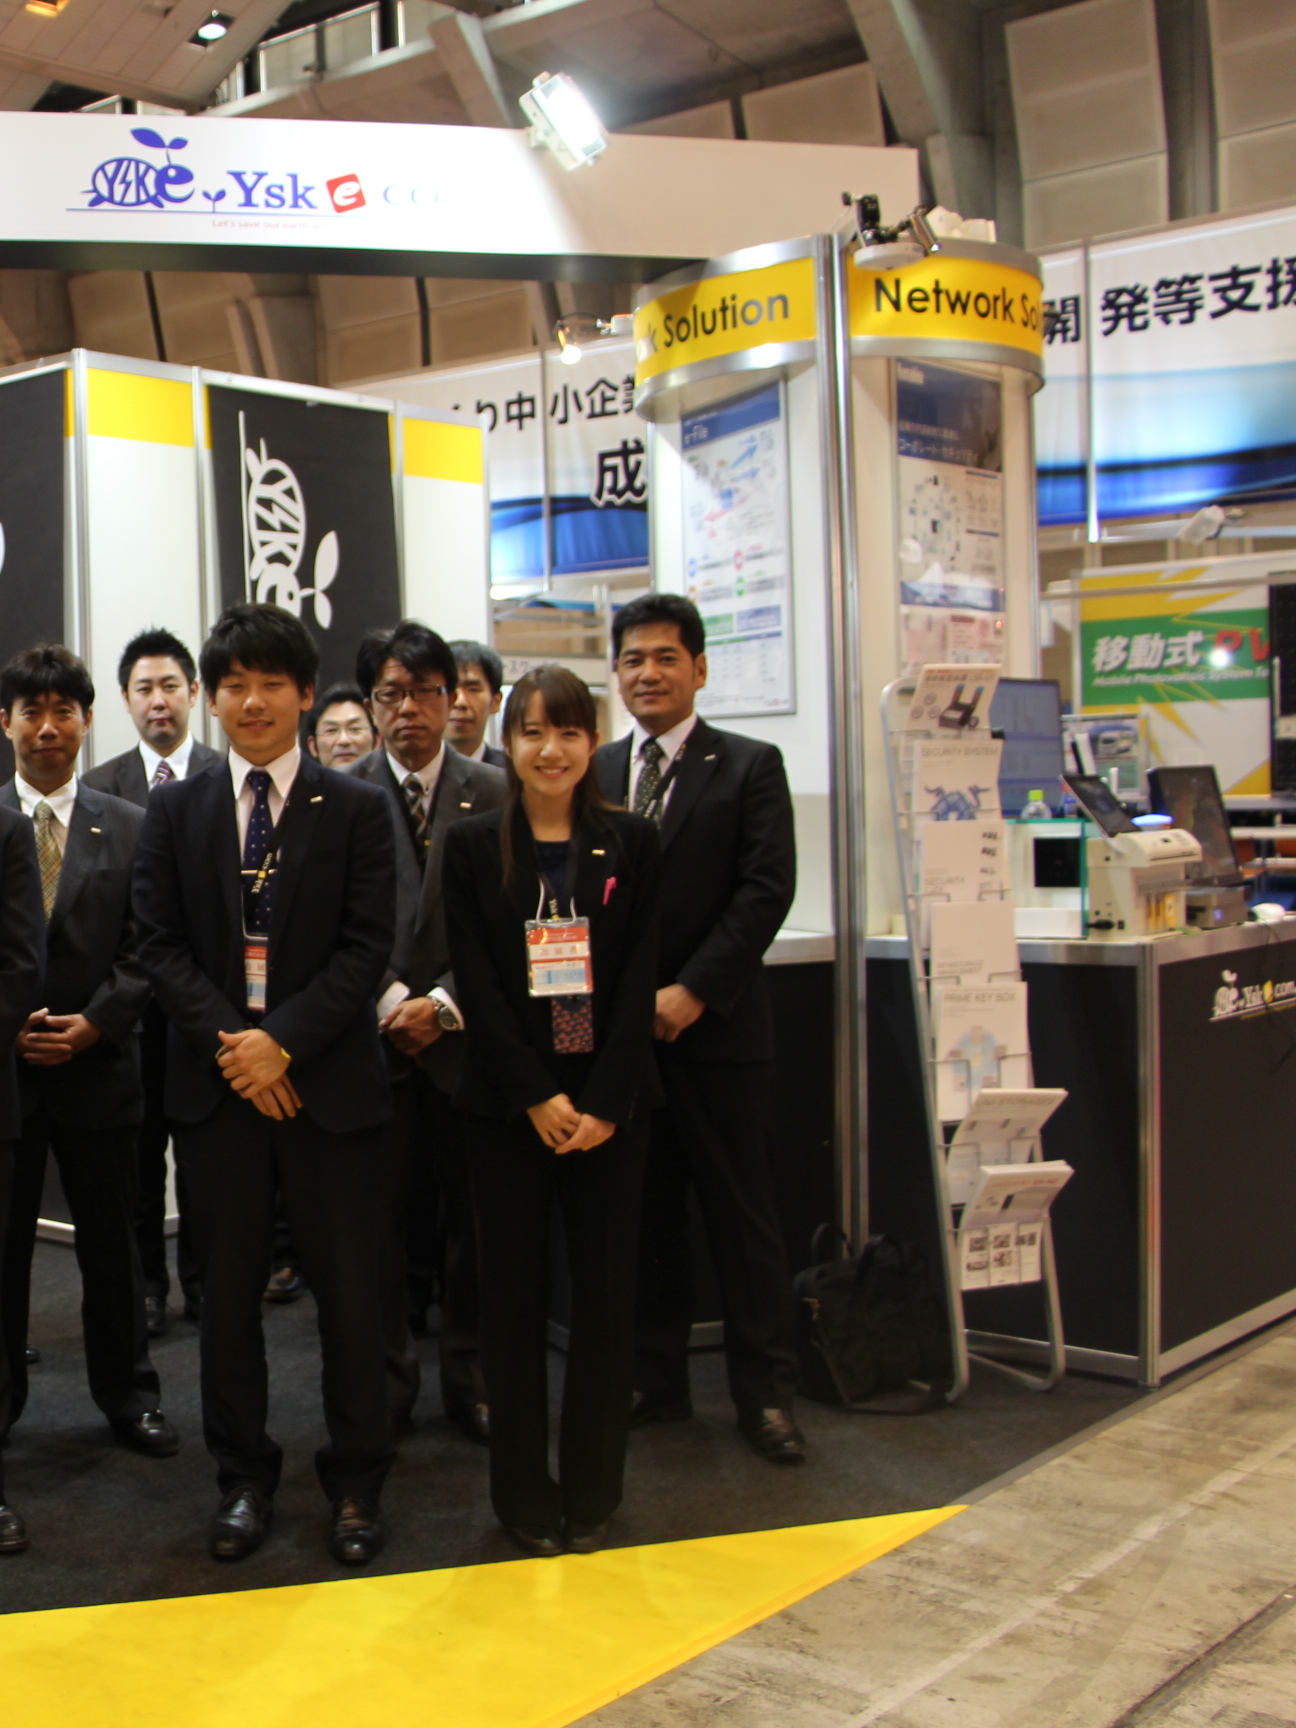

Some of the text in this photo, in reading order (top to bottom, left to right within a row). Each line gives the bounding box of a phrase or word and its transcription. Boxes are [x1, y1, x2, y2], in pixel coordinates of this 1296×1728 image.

[226, 170, 318, 209] Ysk
[663, 293, 789, 348] Solution
[874, 277, 1042, 333] Network So
[1092, 630, 1204, 673] 移動式
[922, 746, 999, 757] SECURITY SYSTEM
[925, 876, 966, 887] SECURITY
[944, 990, 1016, 1002] PRIME KEY BOX
